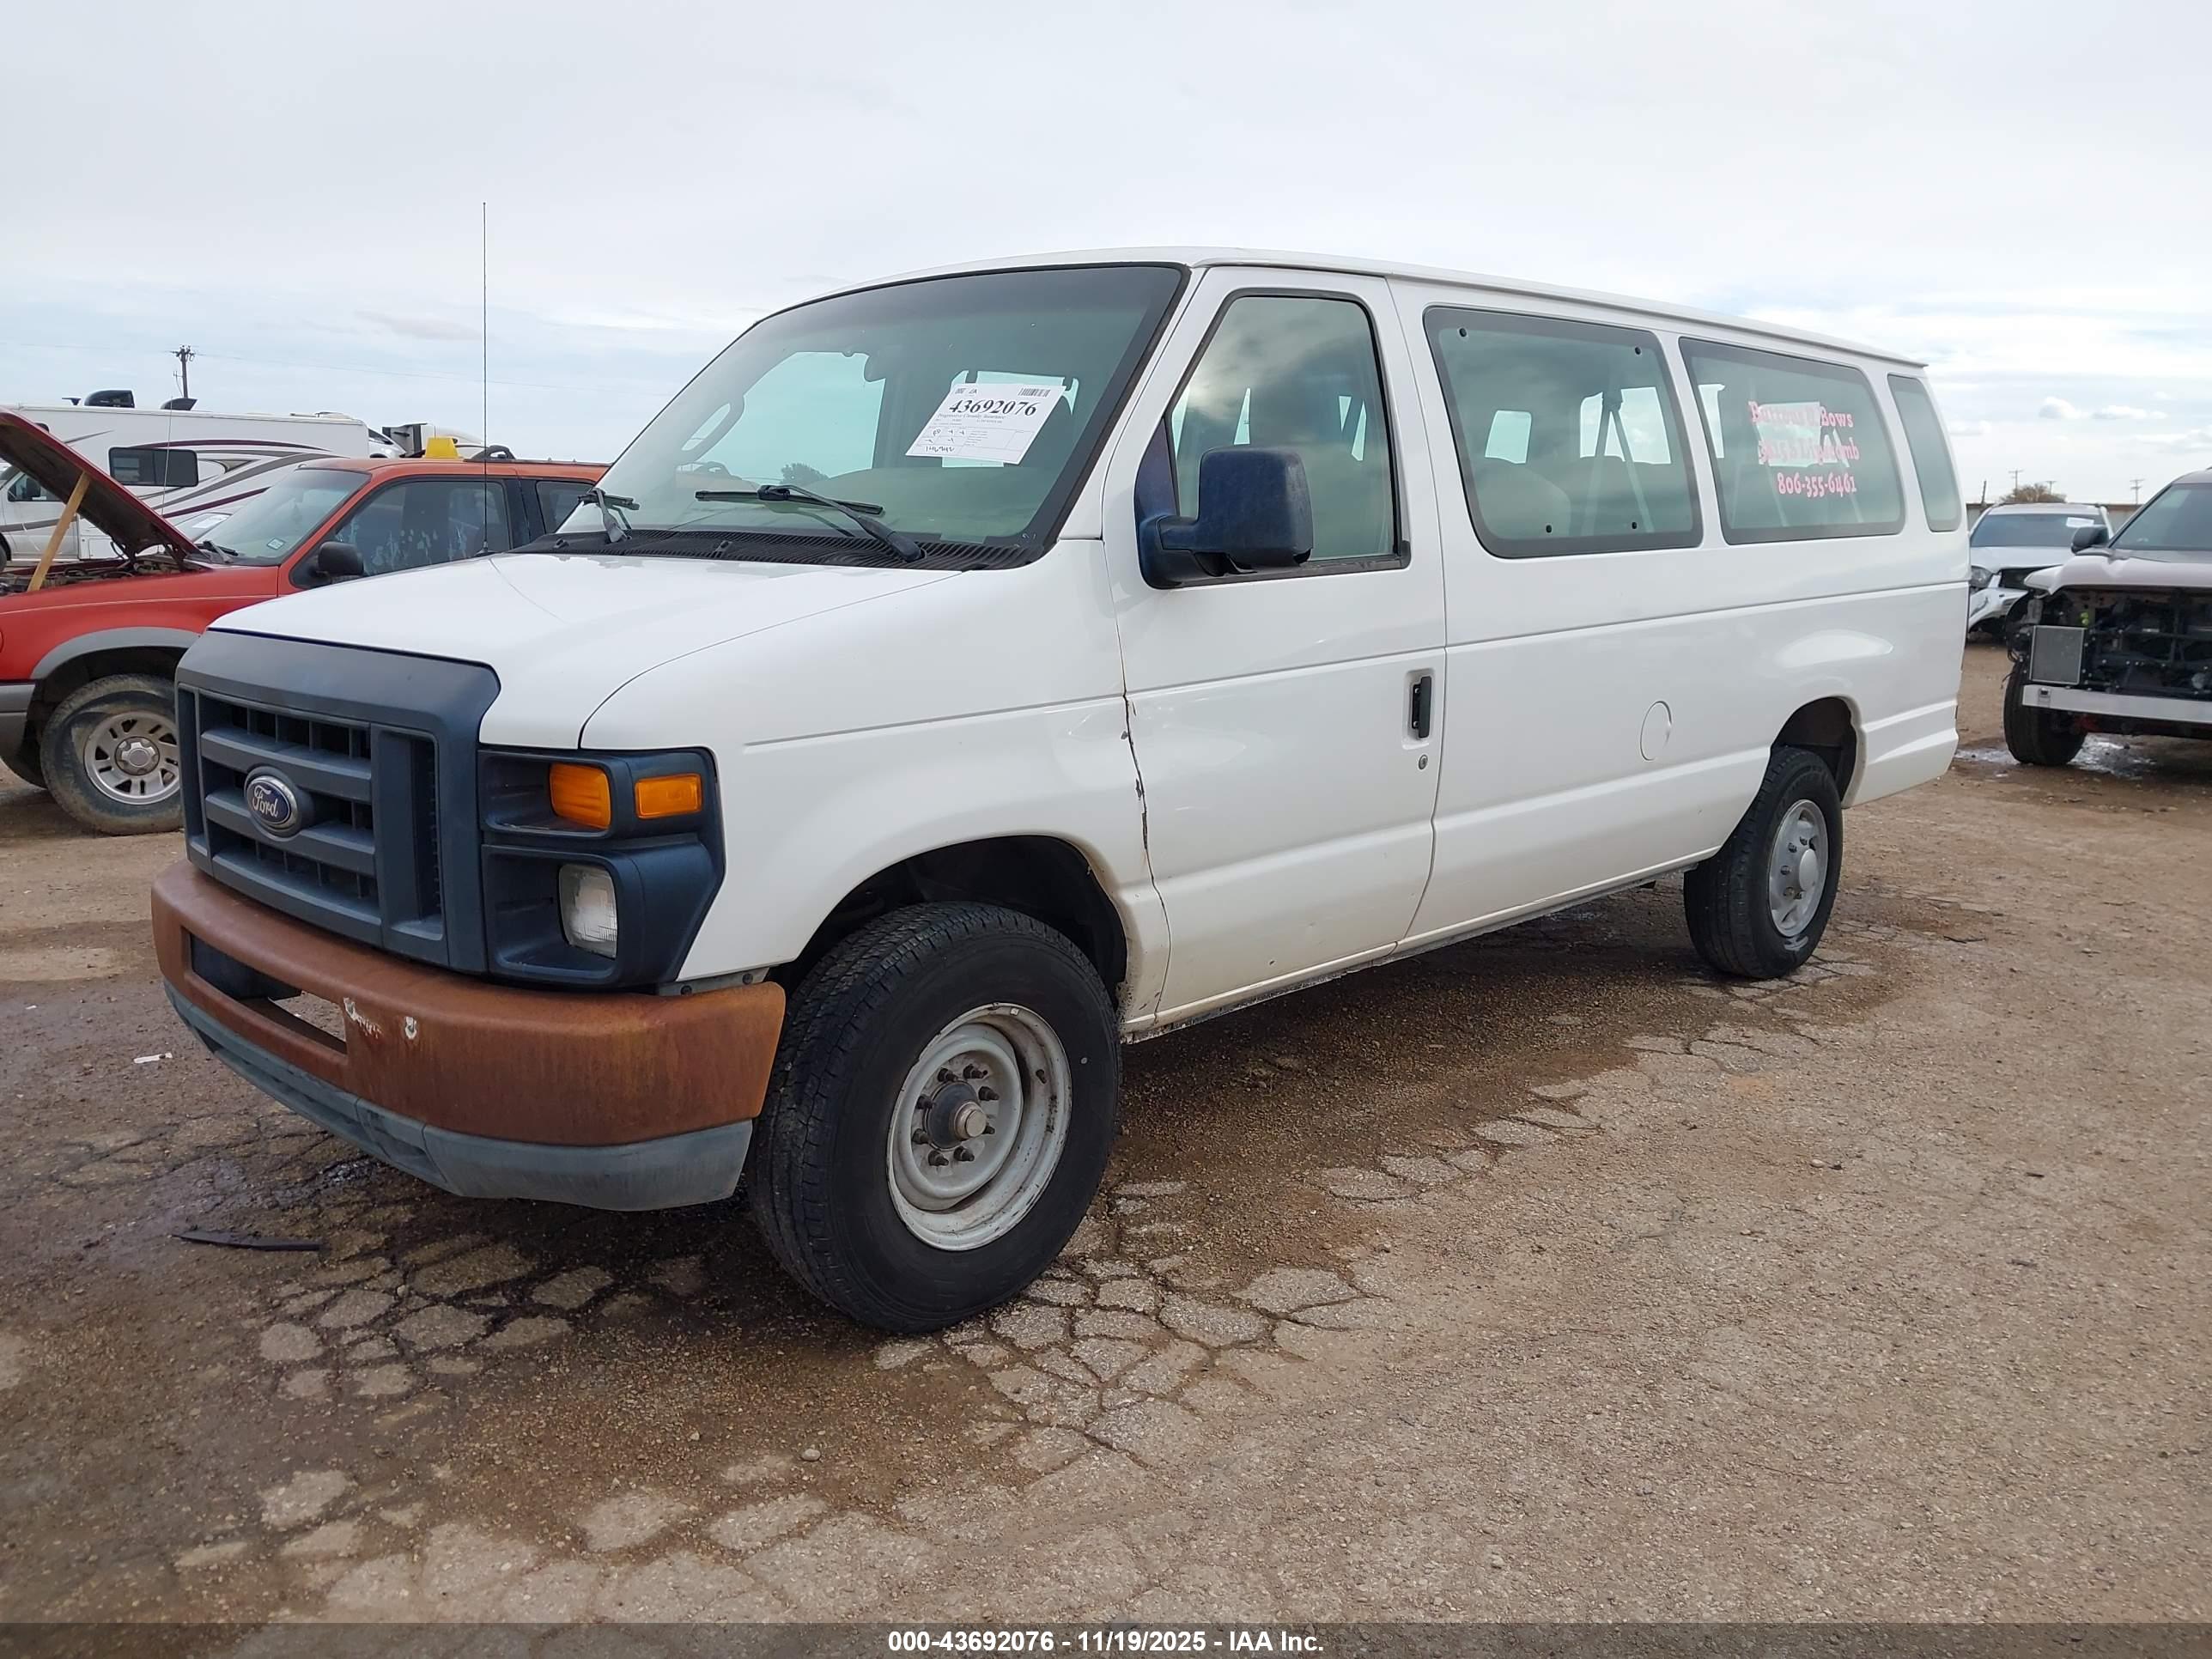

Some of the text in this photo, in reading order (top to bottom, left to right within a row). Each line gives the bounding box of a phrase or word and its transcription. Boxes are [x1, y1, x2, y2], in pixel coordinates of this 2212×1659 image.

[949, 399, 1041, 416] 43692076
[1816, 405, 1854, 428] Bows
[1777, 472, 1857, 498] 806-355-6461
[252, 785, 279, 817] Ford
